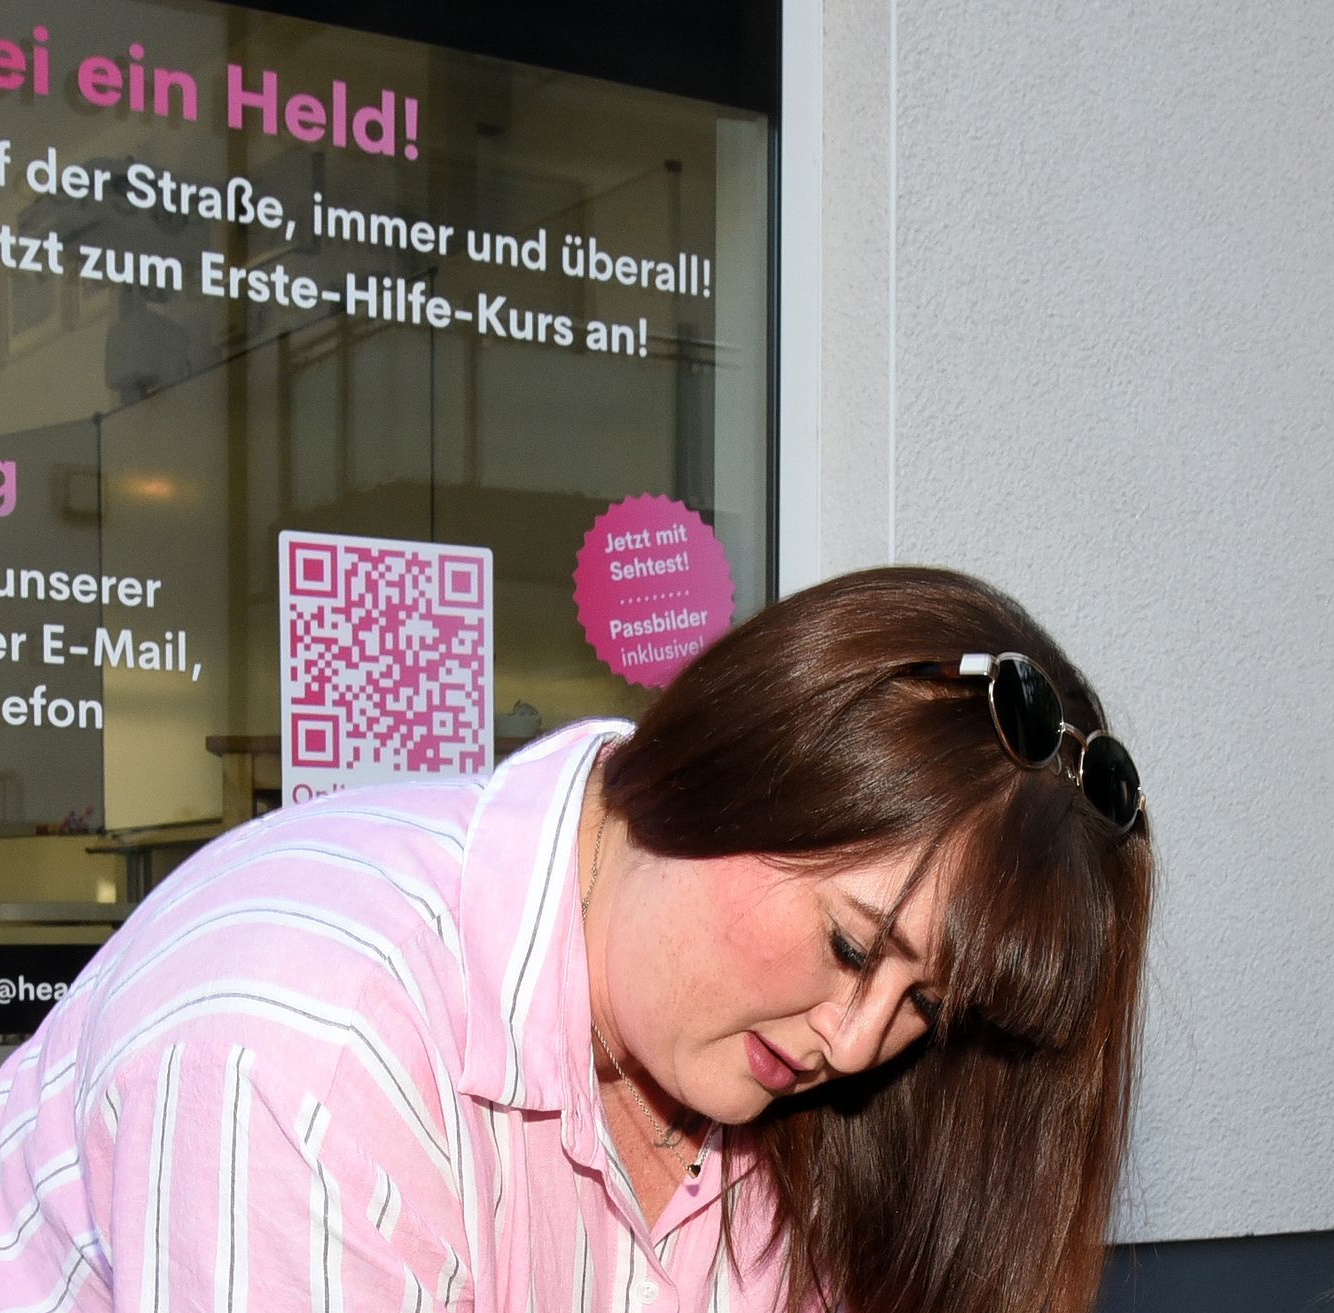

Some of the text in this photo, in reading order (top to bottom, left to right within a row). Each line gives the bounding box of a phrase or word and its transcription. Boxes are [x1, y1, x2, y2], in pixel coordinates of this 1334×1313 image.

[77, 43, 198, 121] ein
[226, 64, 421, 161] Held!
[25, 147, 112, 202] der
[126, 164, 297, 240] Straße,
[312, 192, 455, 255] immer
[466, 228, 547, 273] und
[561, 234, 712, 299] überall!
[79, 245, 184, 292] zum
[201, 251, 574, 347] Erste-Hilfe-Kurs
[585, 317, 649, 358] an!
[604, 523, 687, 554] Jetzt mit
[610, 551, 690, 581] Sehtest!
[42, 623, 204, 683] E-Mail,
[609, 608, 708, 640] Passbilder
